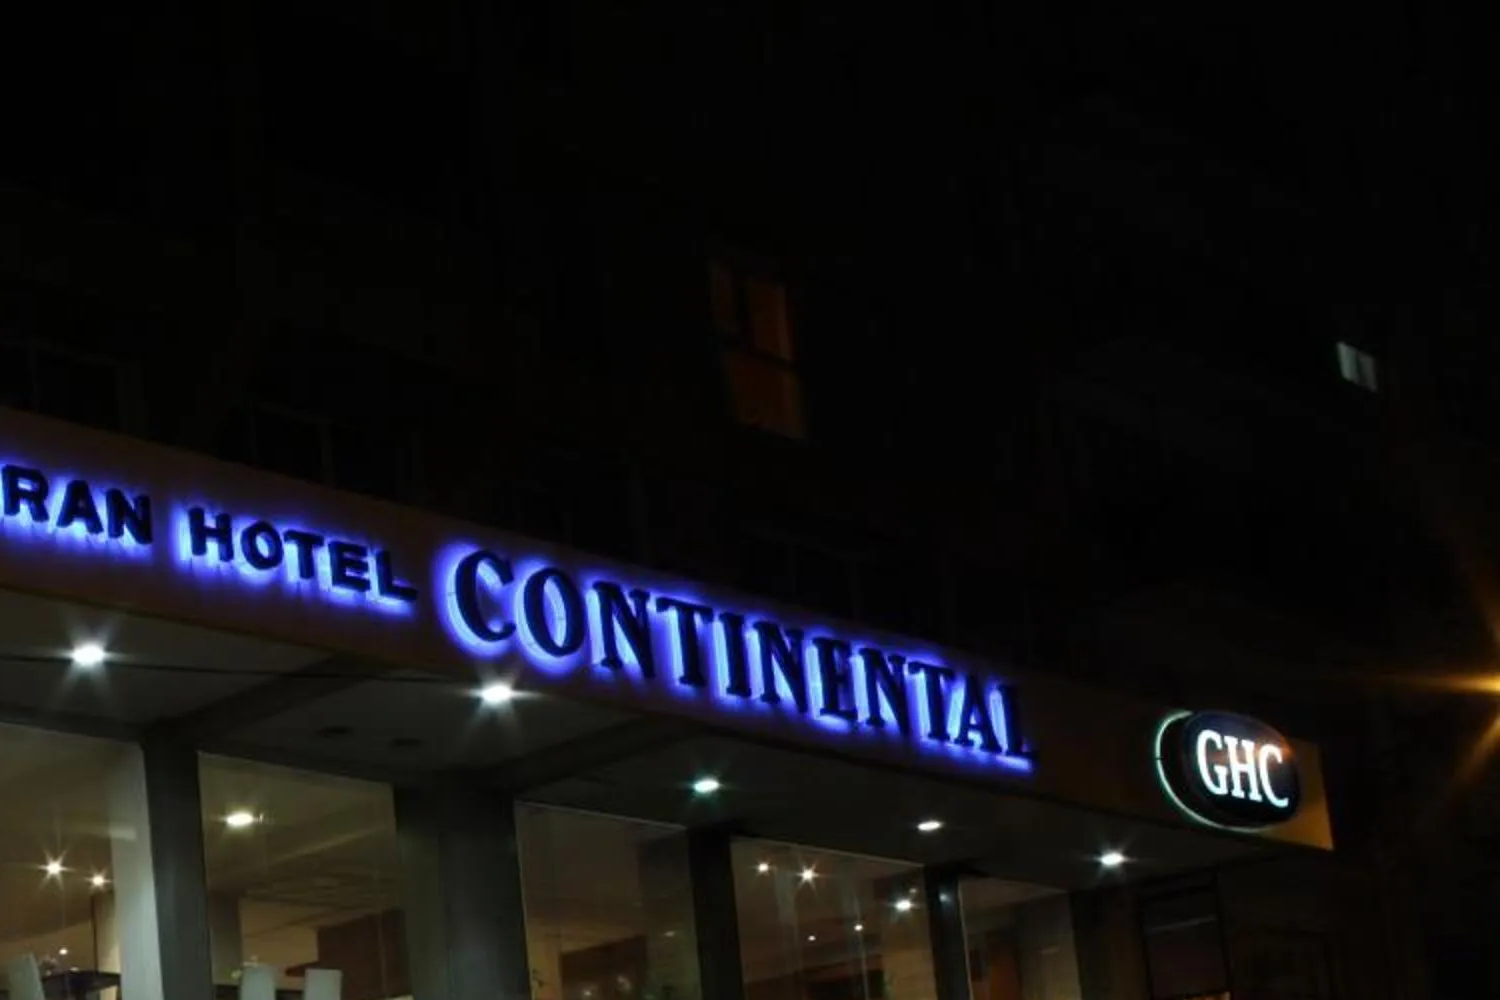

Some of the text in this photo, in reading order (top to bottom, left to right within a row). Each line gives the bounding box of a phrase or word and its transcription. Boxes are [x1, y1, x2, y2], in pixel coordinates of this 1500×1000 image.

[187, 506, 419, 602] HOTEL
[453, 549, 1038, 760] CONTINENTAL
[1197, 729, 1289, 808] GHC
